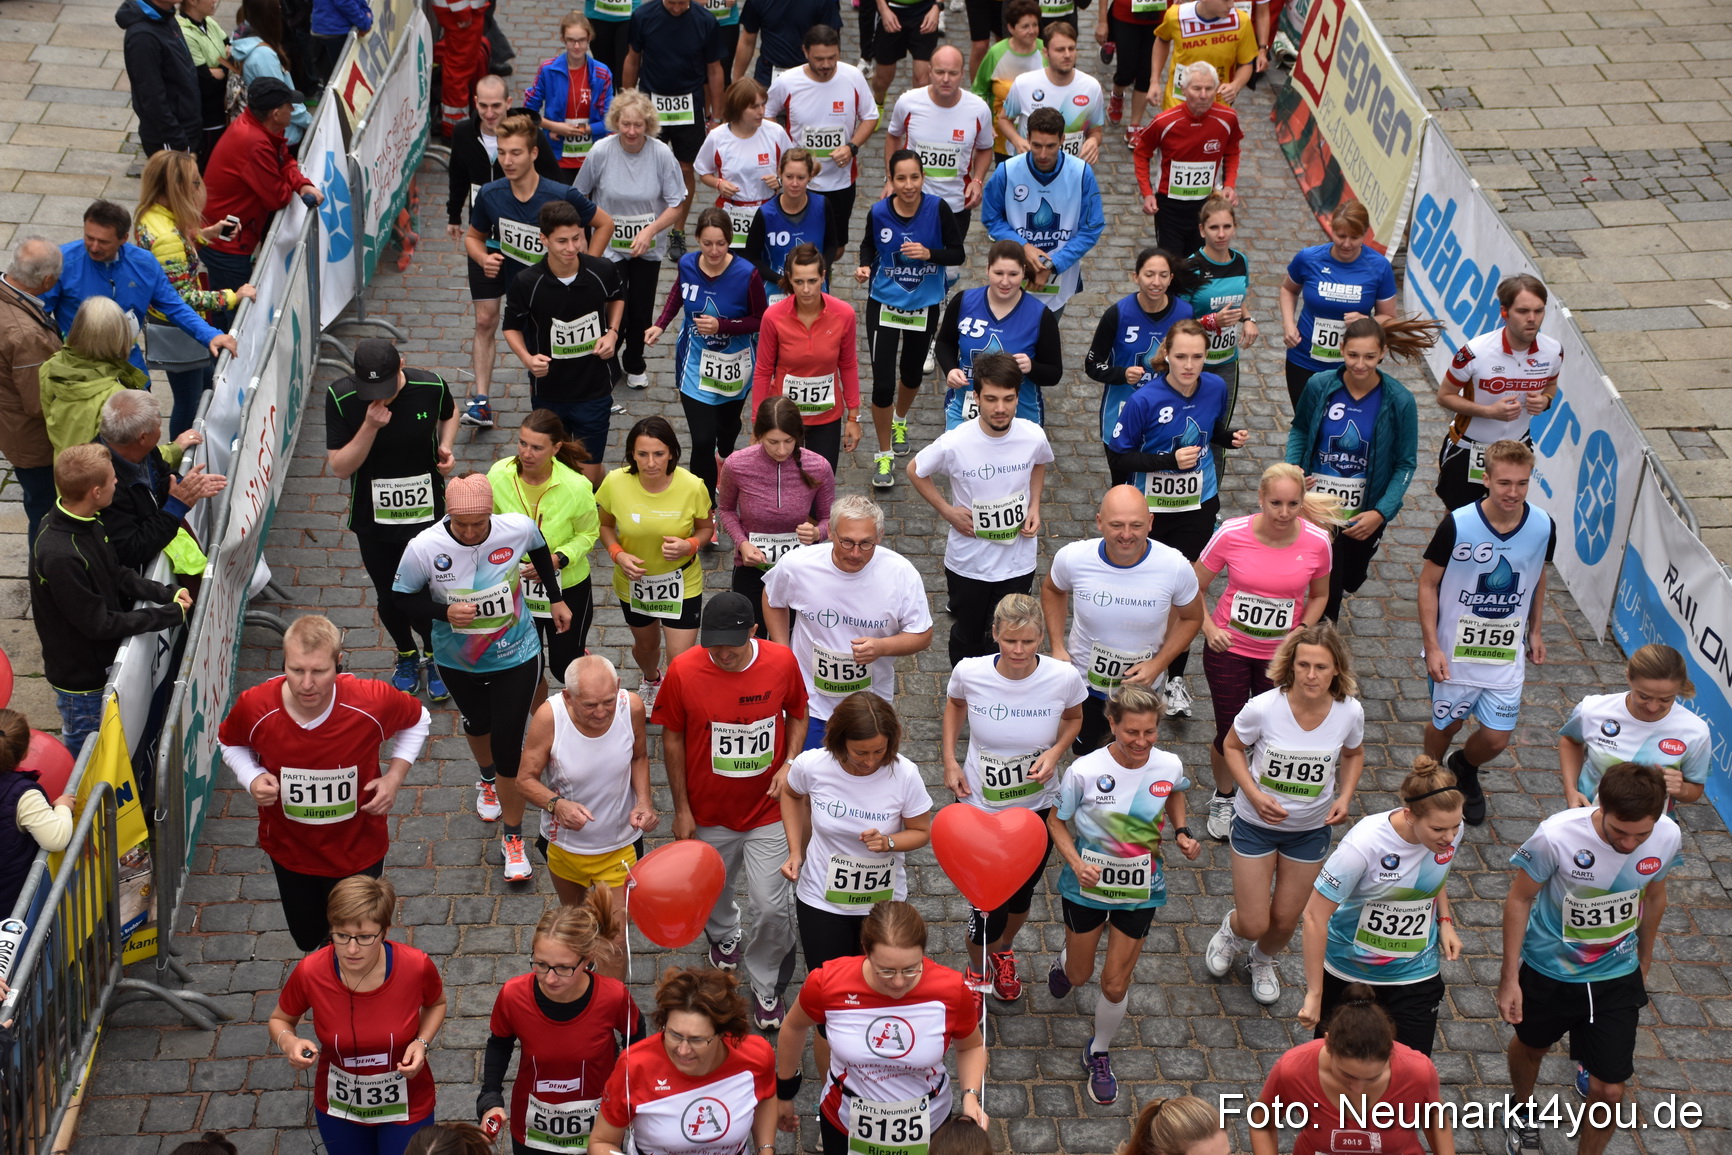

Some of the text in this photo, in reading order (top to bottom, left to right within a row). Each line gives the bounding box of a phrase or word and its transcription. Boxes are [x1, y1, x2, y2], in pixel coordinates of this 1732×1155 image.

[1183, 34, 1239, 49] MAX BÖGL
[657, 97, 689, 111] 5036
[806, 133, 841, 147] 5303
[921, 152, 956, 167] 5305
[1174, 171, 1210, 186] 5123
[1013, 184, 1029, 202] 9
[504, 229, 543, 253] 5165
[767, 231, 791, 246] 10
[880, 228, 893, 243] 9
[681, 283, 699, 302] 11
[1318, 281, 1362, 295] HUBER
[556, 323, 595, 345] 5171
[958, 317, 988, 338] 45
[1125, 326, 1140, 343] 5
[563, 344, 593, 354] Christian
[704, 362, 741, 380] 5138
[788, 386, 830, 402] 5157
[1158, 406, 1174, 424] 8
[1113, 422, 1123, 438] 8
[962, 462, 1031, 478] FeG NEUMARKT
[1152, 477, 1198, 494] 5030
[380, 487, 428, 508] 5052
[1157, 498, 1189, 506] Christina
[979, 504, 1024, 529] 5108
[1451, 542, 1493, 563] 66
[471, 591, 500, 602] Neumarkt
[634, 582, 679, 600] 5120
[1618, 578, 1642, 617] AUF
[1115, 597, 1156, 607] NEUMARKT
[843, 616, 889, 629] NEUMARKT
[1237, 603, 1287, 628] 5076
[1459, 619, 1481, 627] PARTL
[1244, 627, 1272, 637] Andrea
[1462, 627, 1515, 646] 5159
[1464, 648, 1505, 658] Alexander
[818, 659, 868, 680] 5153
[824, 682, 860, 692] Christian
[1011, 708, 1051, 717] NEUMARKT
[1433, 700, 1471, 720] 66
[738, 725, 766, 734] Neumarkt
[720, 732, 770, 755] 5170
[1661, 741, 1684, 752] Hervis
[980, 755, 1001, 765] PARTL
[1266, 749, 1288, 760] PARTL
[734, 759, 759, 770] Vitaly
[1267, 760, 1325, 782] 5193
[290, 782, 351, 804] 5110
[1000, 788, 1027, 799] Esther
[1152, 783, 1172, 794] Hervis
[1275, 783, 1309, 795] Martina
[303, 806, 337, 818] Jürgen
[849, 808, 890, 822] NEUMARKT
[831, 857, 854, 867] PARTL
[1083, 854, 1105, 865] PARTL
[1639, 862, 1659, 870] Hervis
[834, 868, 891, 890] 5154
[1102, 868, 1145, 886] 090
[1572, 870, 1595, 878] PARTL
[849, 895, 871, 903] Irene
[1565, 897, 1627, 909] PARTL Neumarkt
[1367, 902, 1424, 913] PARTL Neumarkt
[1571, 902, 1633, 927] 5319
[1367, 910, 1426, 936] 5322
[1365, 933, 1407, 949] Tatjana
[356, 1057, 376, 1065] DEHN
[330, 1068, 393, 1086] PARTL Neumarkt
[335, 1080, 400, 1105] 5133
[548, 1082, 568, 1090] DEHN
[350, 1106, 383, 1116] Carina
[530, 1100, 592, 1116] PARTL Neumarkt
[853, 1102, 917, 1116] PARTL Neumarkt
[533, 1114, 594, 1134] 5061
[857, 1114, 923, 1143] 5135
